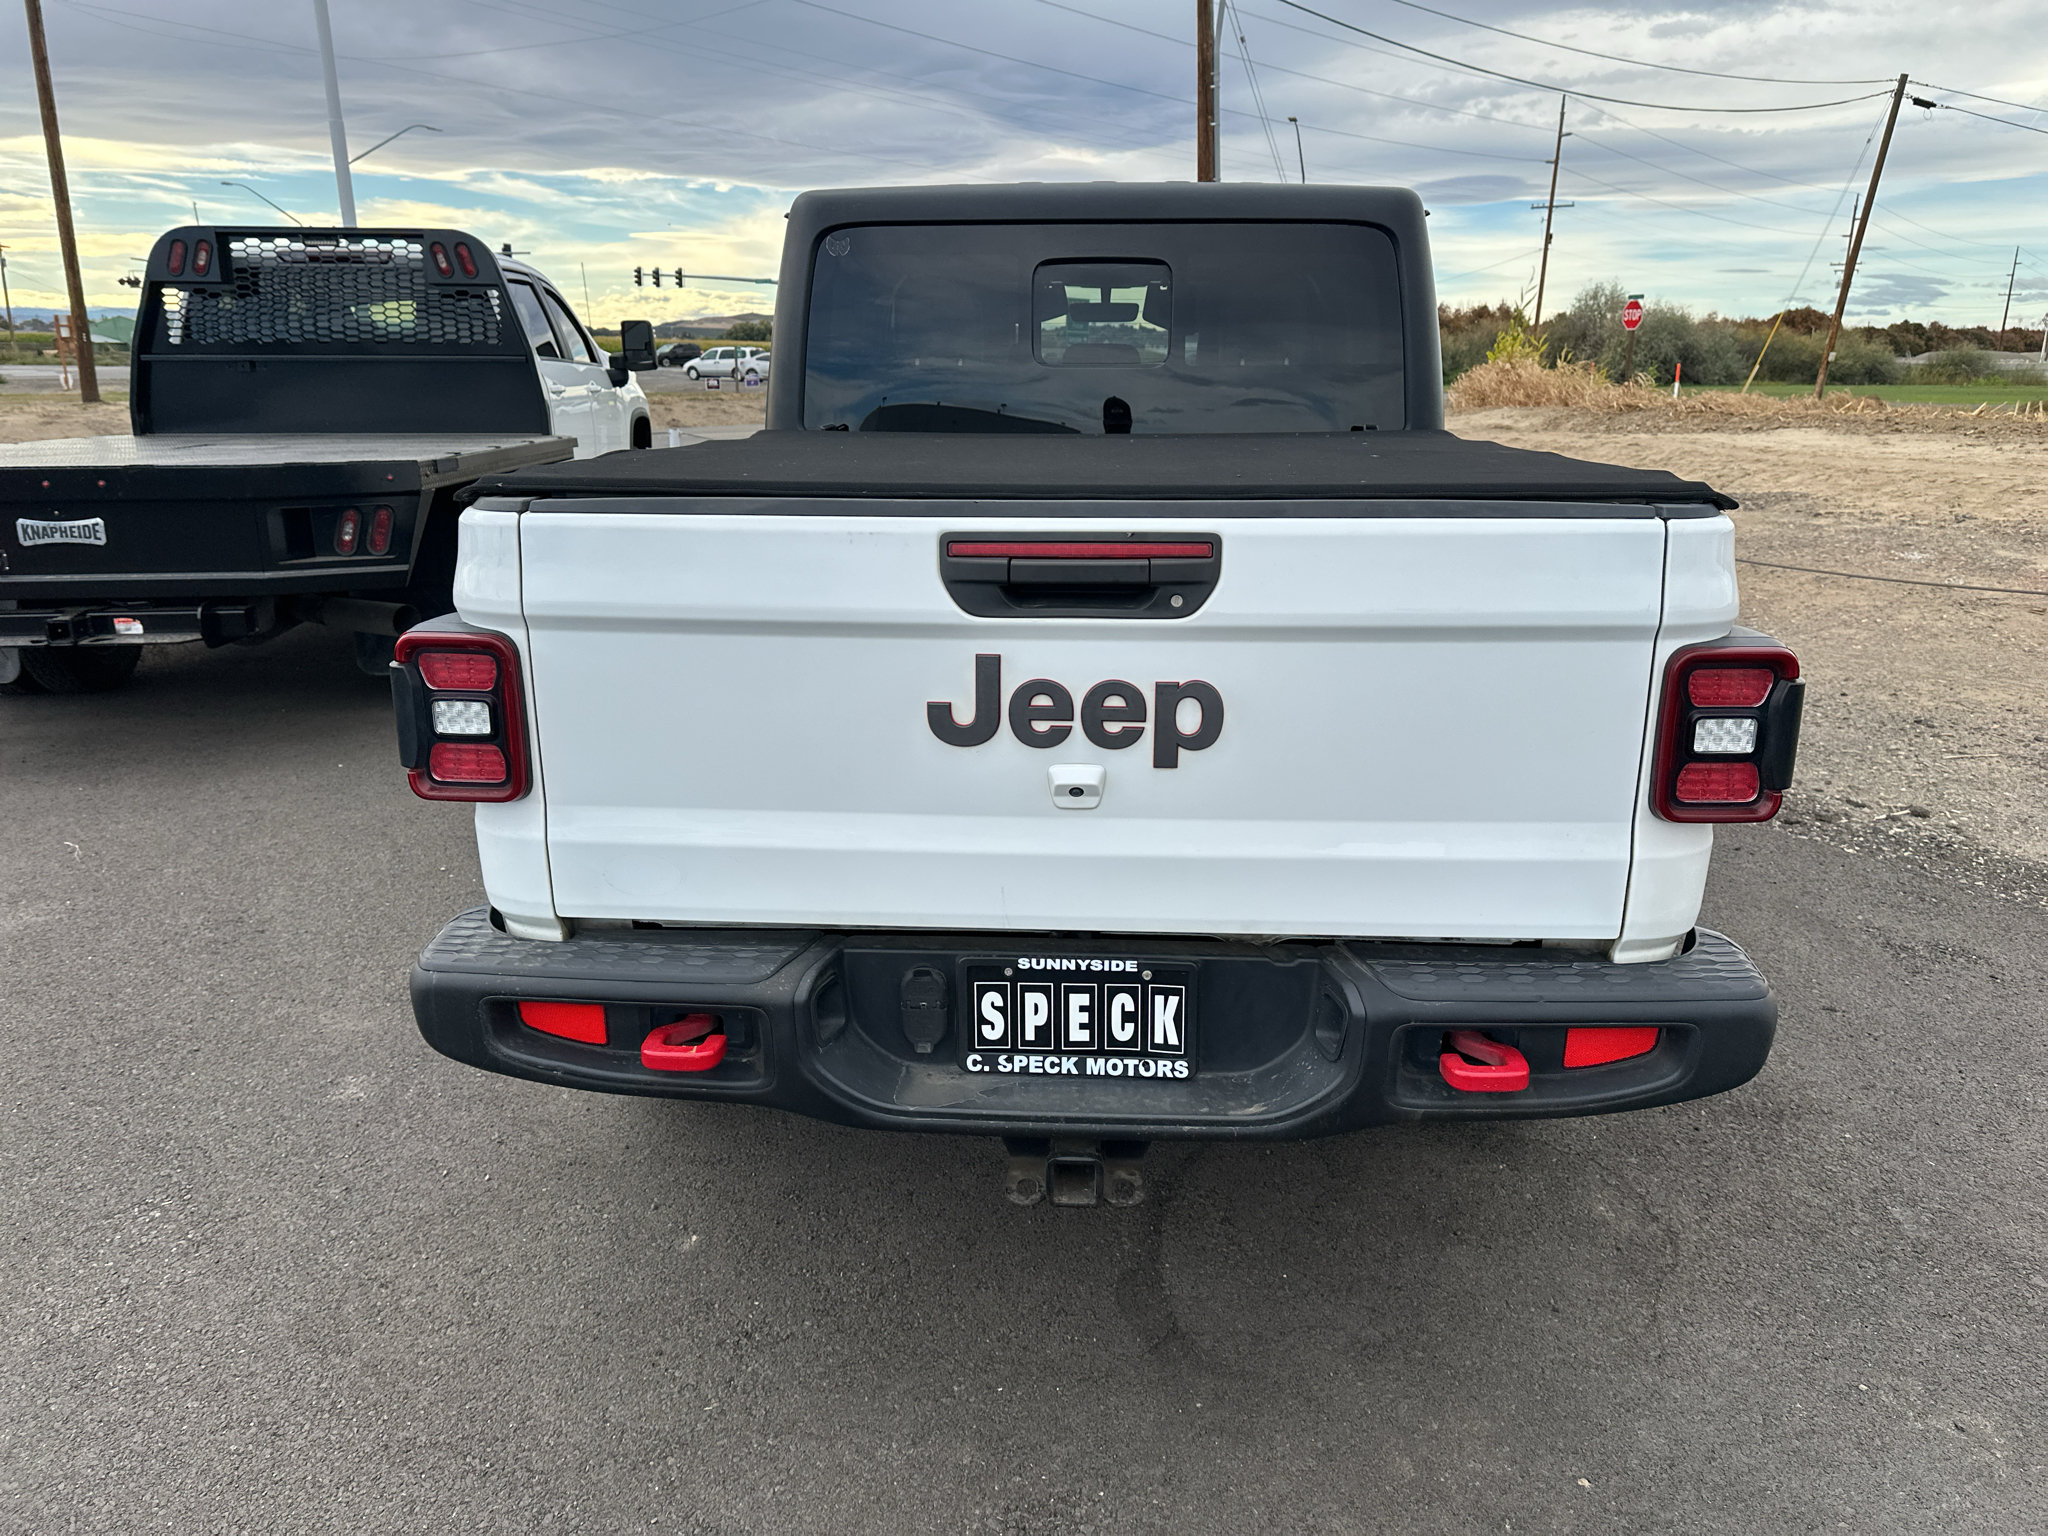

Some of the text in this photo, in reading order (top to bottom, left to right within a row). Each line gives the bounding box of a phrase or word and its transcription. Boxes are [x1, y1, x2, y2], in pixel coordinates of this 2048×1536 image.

[1624, 309, 1641, 321] STOP
[20, 522, 103, 541] KNAPHEIDE
[926, 653, 1225, 769] Jeep
[1017, 957, 1138, 972] SUNNYSIDE
[980, 991, 1180, 1046] SPECK
[966, 1053, 1189, 1079] C. SPECK MOTORS
